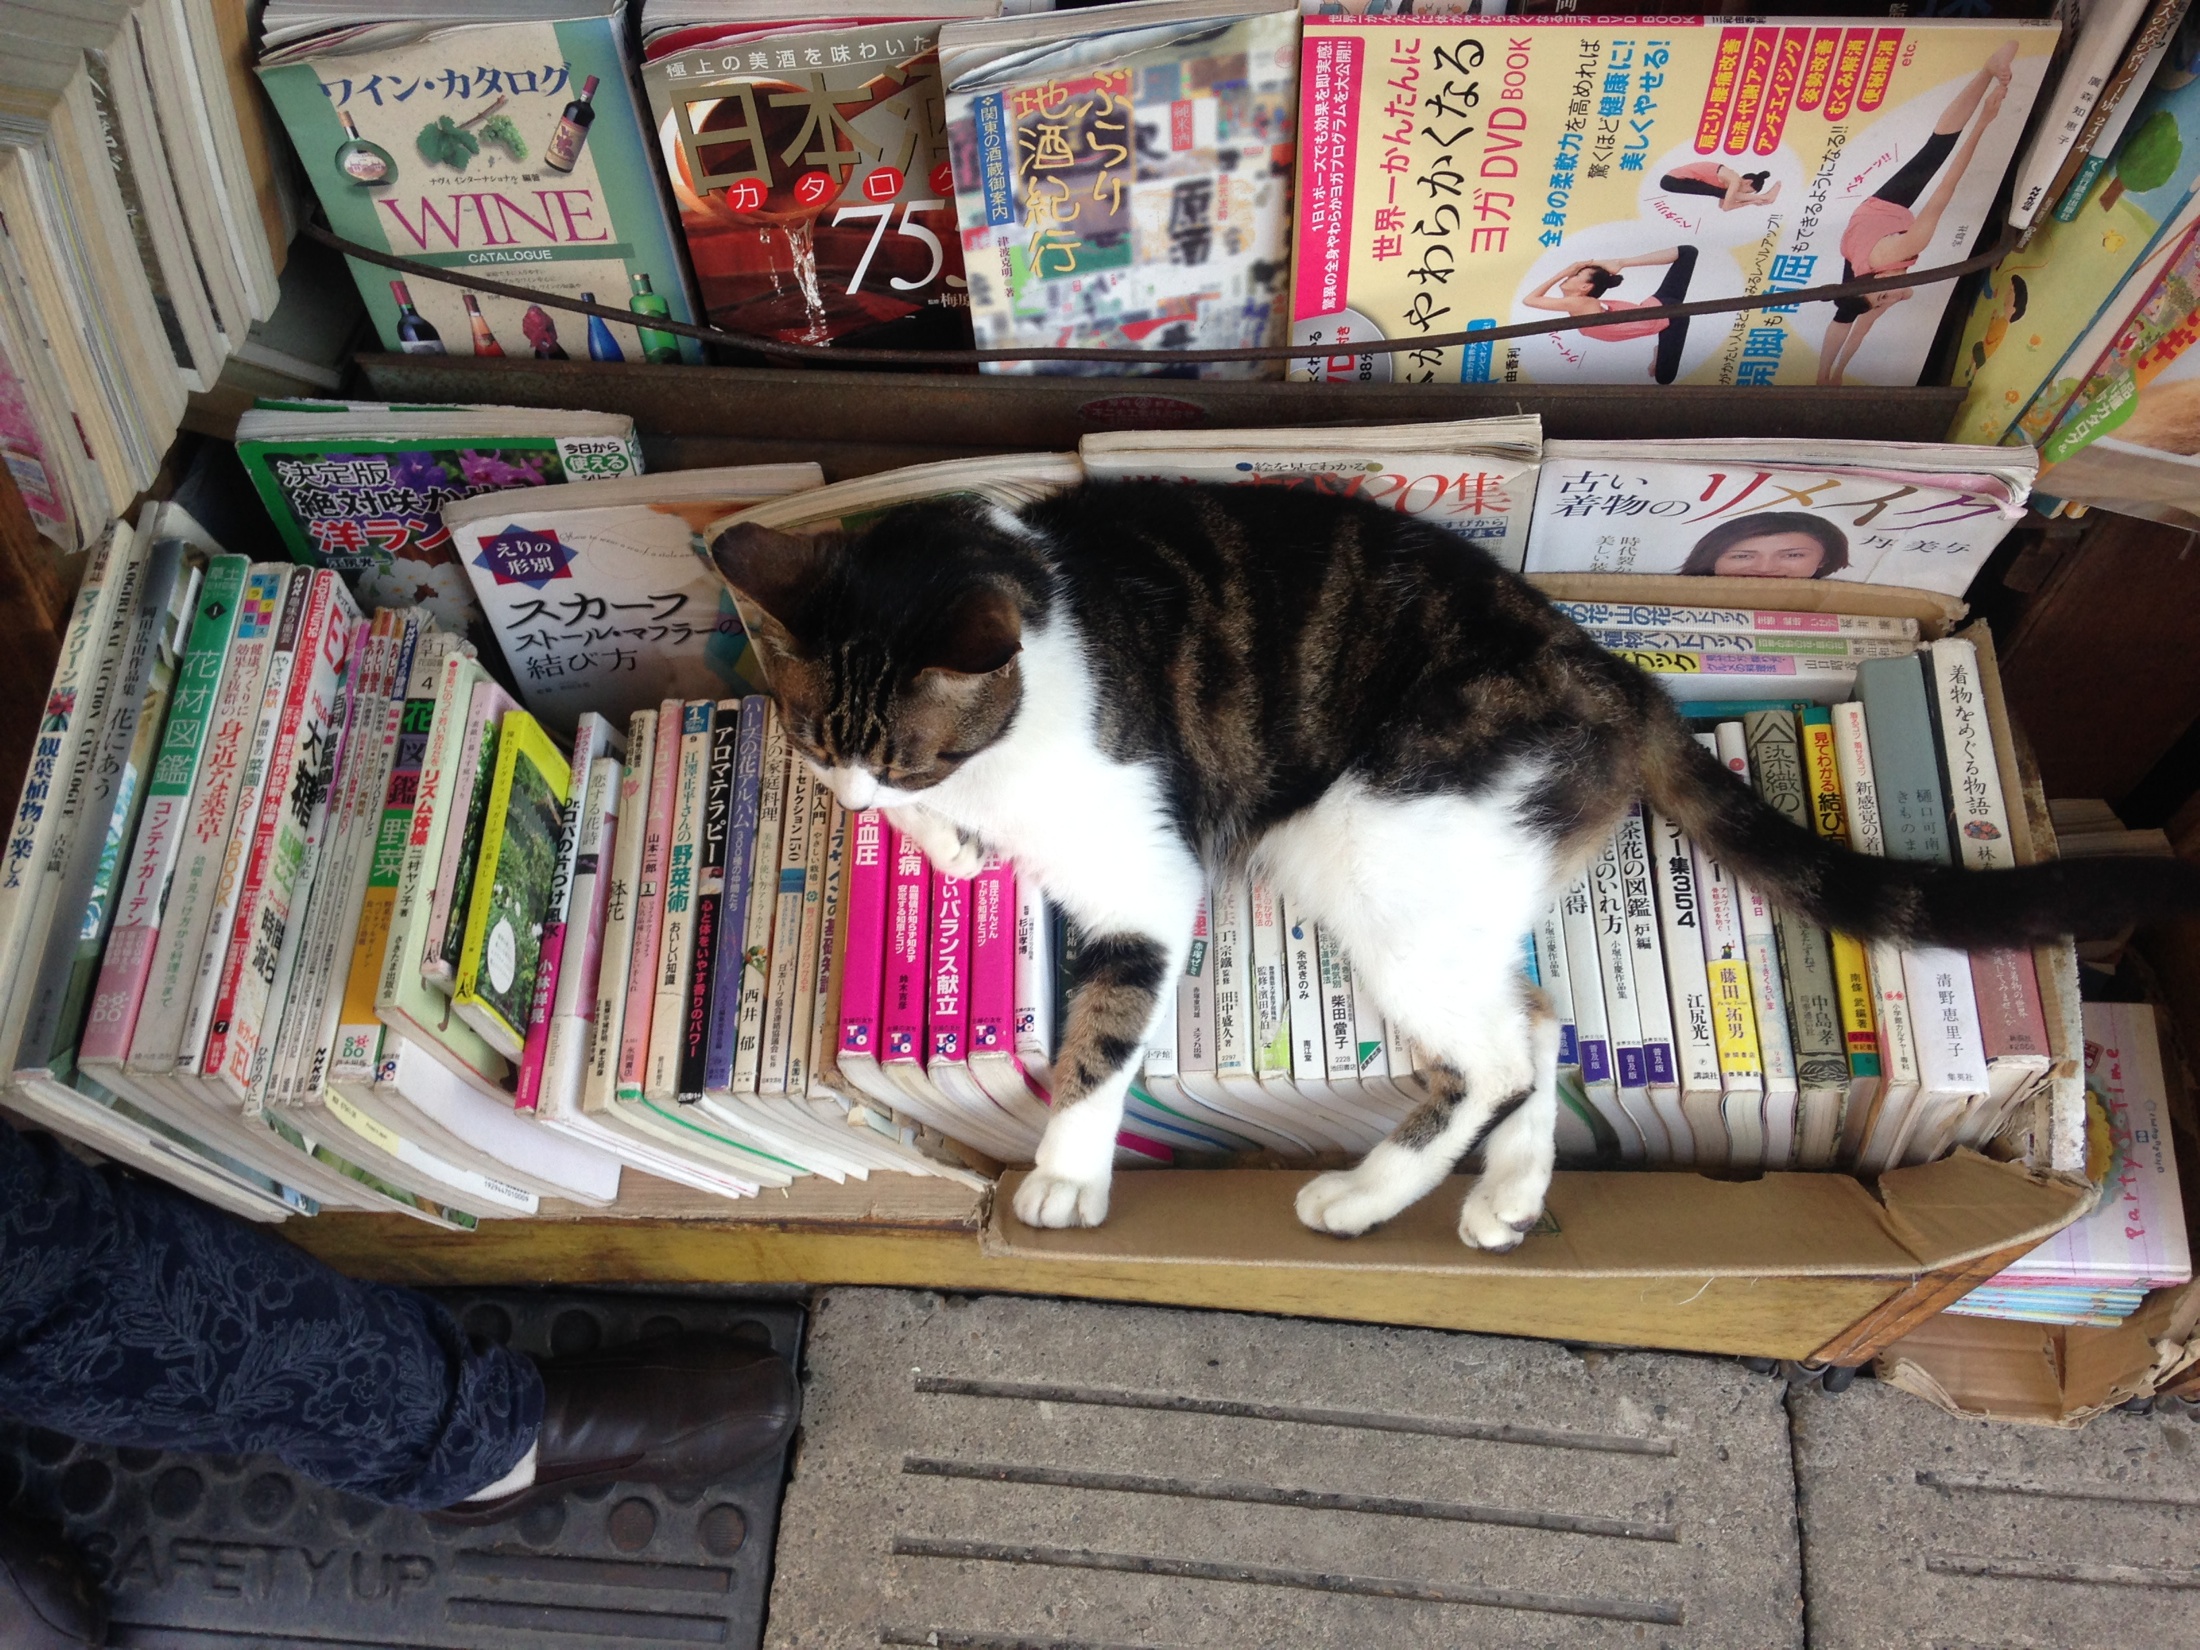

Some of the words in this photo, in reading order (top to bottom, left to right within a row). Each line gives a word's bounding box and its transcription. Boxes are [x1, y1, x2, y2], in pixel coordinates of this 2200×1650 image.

[1597, 15, 1637, 25] DVD
[1642, 15, 1696, 25] BOOK
[1501, 36, 1533, 101] BOOK
[1800, 39, 1835, 104] 姿勢改善
[1828, 39, 1865, 117] むくみ解消
[1860, 39, 1897, 105] 便秘解消
[1901, 39, 1919, 68] etc.
[318, 61, 572, 108] ワイン・カタログ
[1586, 39, 1636, 180] 驚くほど健康に!
[1619, 39, 1672, 172] 美しくやせる!
[1698, 38, 1742, 150] 肩こり・腰痛改善
[1727, 37, 1771, 150] 血流・代謝アップ
[1756, 38, 1801, 152] アンチエイジング
[980, 105, 1011, 221] 関東の酒蔵御案内
[1074, 67, 1136, 217] ぶらり
[1310, 39, 1334, 232] 1日1ポーズでも効果を即実感!
[1371, 37, 1422, 262] 世界一かんたんに
[1480, 105, 1529, 179] DVD
[1538, 38, 1602, 248] 全身の柔軟力を高めれば
[454, 174, 519, 186] インターナショナル
[1011, 78, 1083, 279] 地酒紀行
[1321, 39, 1354, 311] 驚異の全身やわらかヨガプログラムを大公開!!
[379, 189, 608, 251] WINE
[1470, 187, 1515, 254] ヨガ
[468, 249, 553, 265] CATALOGUE
[277, 459, 397, 489] 決定版
[564, 440, 622, 455] 今日から
[570, 454, 625, 472] 使える
[1254, 461, 1367, 474] 絵を見てわかる
[1551, 494, 1692, 518] 着物の
[1560, 469, 1649, 493] 古い
[1681, 470, 2003, 533] リメイク
[310, 518, 451, 554] 洋ラン
[495, 540, 552, 559] えりの
[507, 555, 556, 576] 形別
[506, 591, 690, 630] スカーフ
[514, 617, 749, 652] ストール・マフラーの
[421, 677, 434, 691] 4
[526, 648, 639, 680] 結び方
[151, 649, 222, 785] 花材図鑑
[1948, 663, 1993, 817] 着物をめぐる物語
[195, 718, 244, 844] 身近な薬草
[705, 726, 736, 864] アロマテラピー
[732, 703, 763, 829] ハーブの花アルバム
[1762, 744, 1801, 814] 染織の
[3, 736, 62, 890] 観葉植物の楽しみ
[409, 768, 440, 848] リズム体操
[581, 773, 608, 846] 恋する花詩
[855, 807, 880, 867] 高血圧
[1855, 780, 1885, 857] 新感覚の着
[125, 801, 173, 928] コンテナガーデン
[1618, 819, 1652, 919] 茶花の図鑑
[976, 879, 989, 948] 下がる知恵とコツ
[988, 879, 1000, 940] 血圧がどんどん
[1634, 922, 1652, 951] 炉編
[664, 921, 682, 986] おいしい知識
[1295, 949, 1310, 1000] 余宮きのみ
[1610, 940, 1628, 999] 小堀宗慶作品集
[1719, 967, 1740, 1000] 藤田
[742, 987, 760, 1022] 西井
[1220, 991, 1235, 1040] 田中盛久
[1330, 994, 1349, 1050] 柴田當子
[1686, 994, 1710, 1048] 江尻光一
[1725, 1006, 1745, 1041] 拓男
[1810, 994, 1836, 1046] 中島孝
[1935, 971, 1965, 1059] 清野恵里子
[1221, 1054, 1237, 1062] 2297
[1302, 1039, 1313, 1063] 南江堂
[1334, 1056, 1351, 1064] 2228
[1588, 1043, 1601, 1071] 普及版
[1625, 1053, 1639, 1081] 普及版
[1651, 1045, 1665, 1073] 普及版
[1693, 1071, 1720, 1081] 講談社
[1946, 1072, 1976, 1083] 集英社
